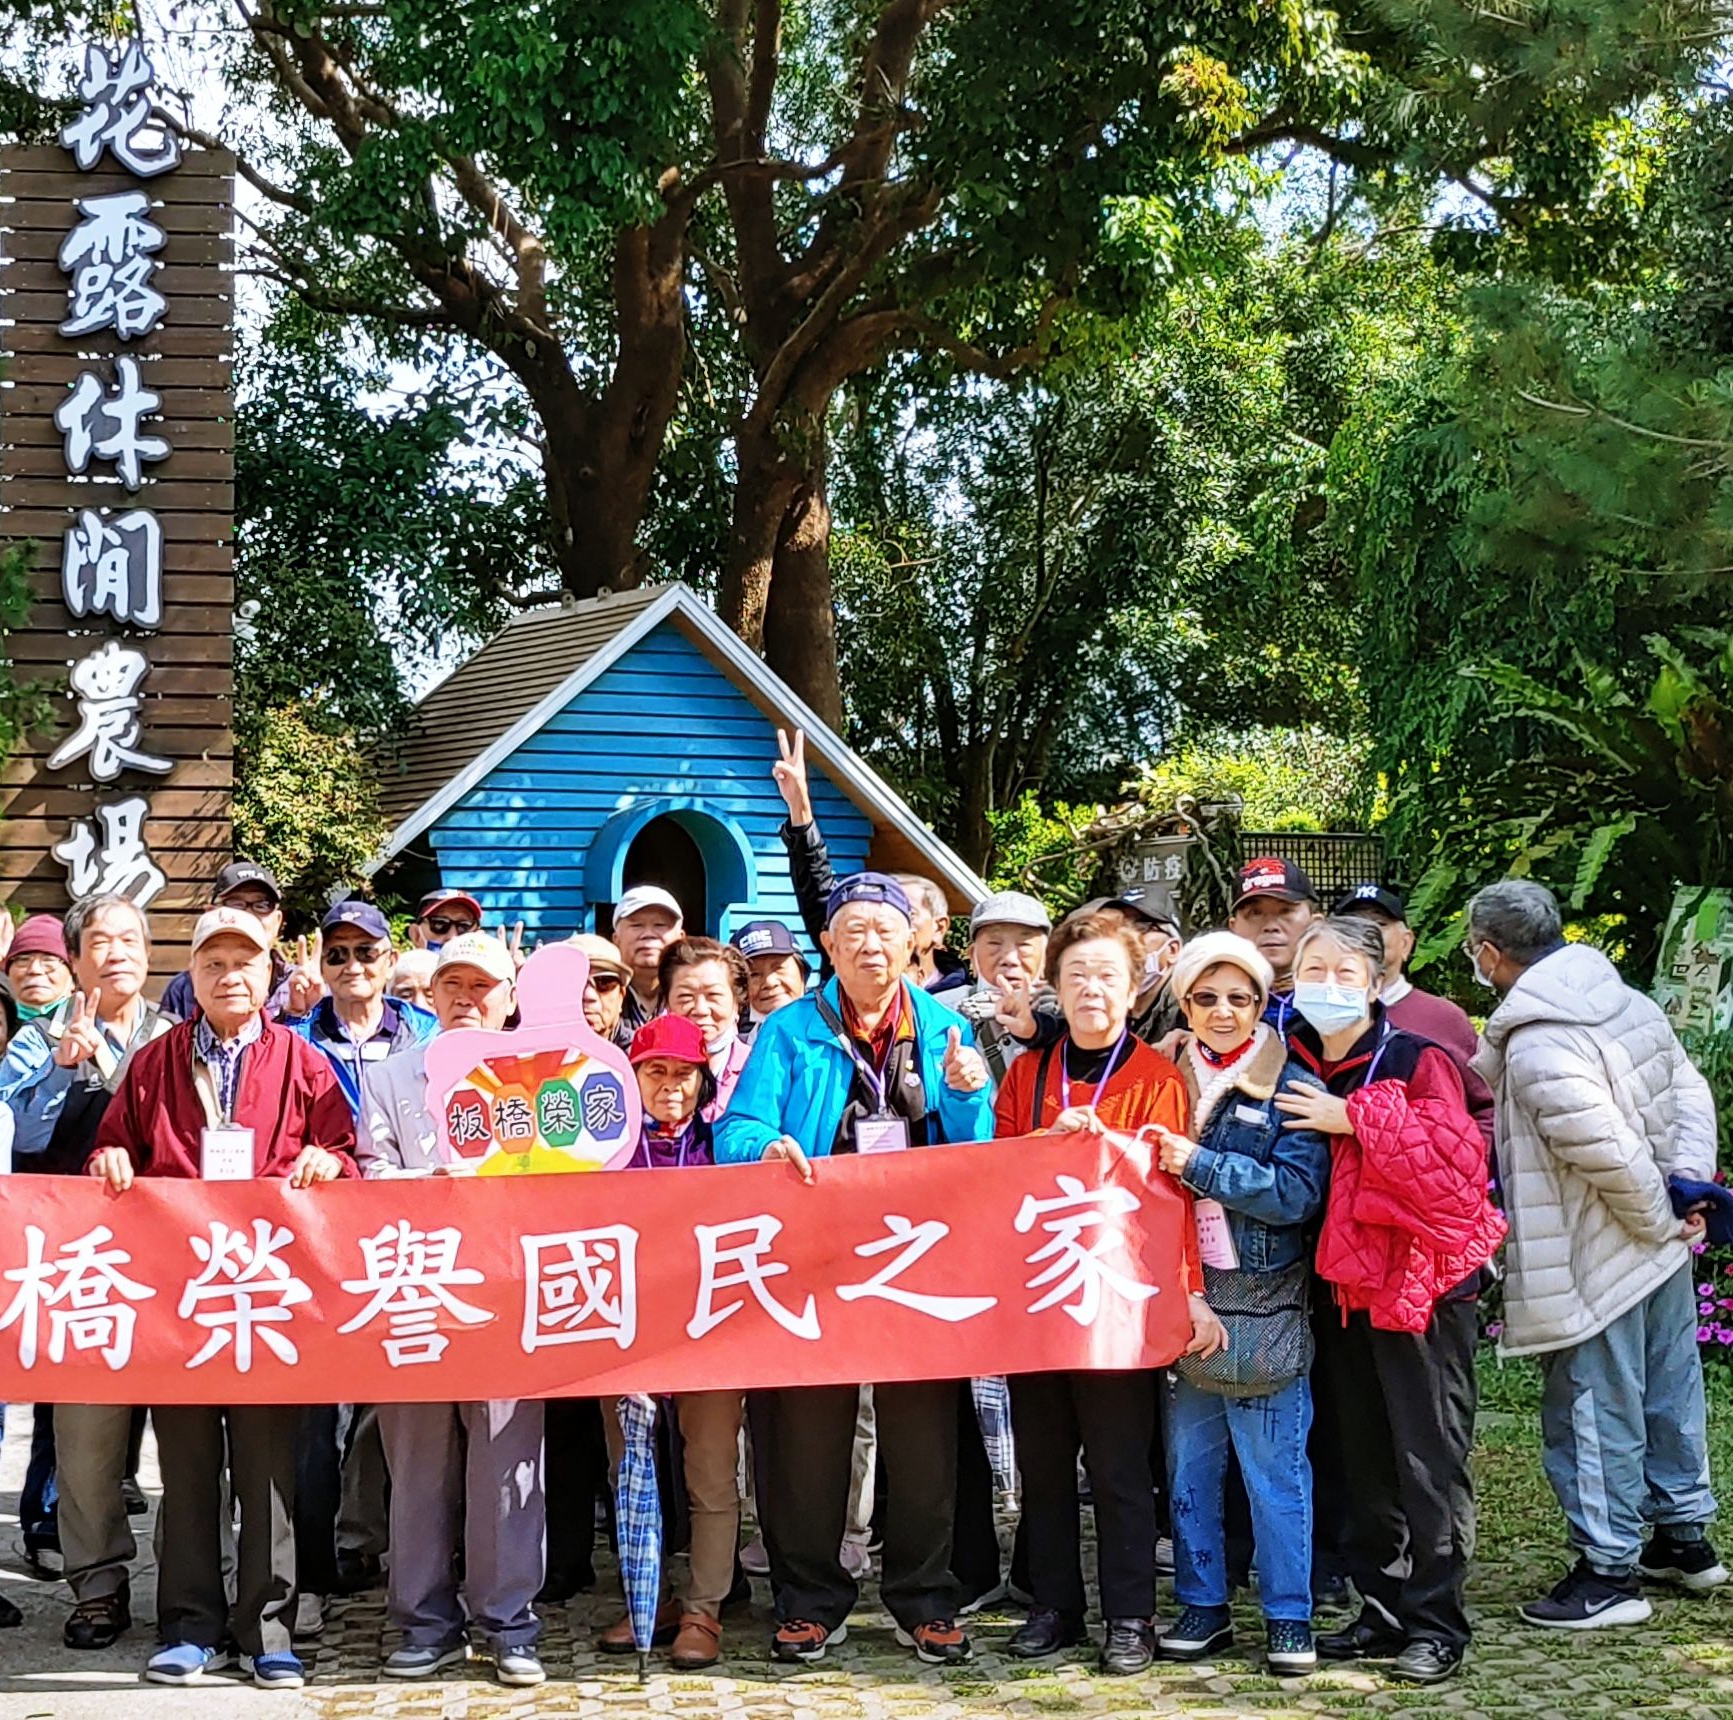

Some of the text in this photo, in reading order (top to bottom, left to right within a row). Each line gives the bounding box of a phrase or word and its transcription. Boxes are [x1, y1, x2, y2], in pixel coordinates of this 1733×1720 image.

[1242, 874, 1285, 892] dragon
[1355, 885, 1379, 898] NY
[449, 1085, 625, 1145] 板橋榮家
